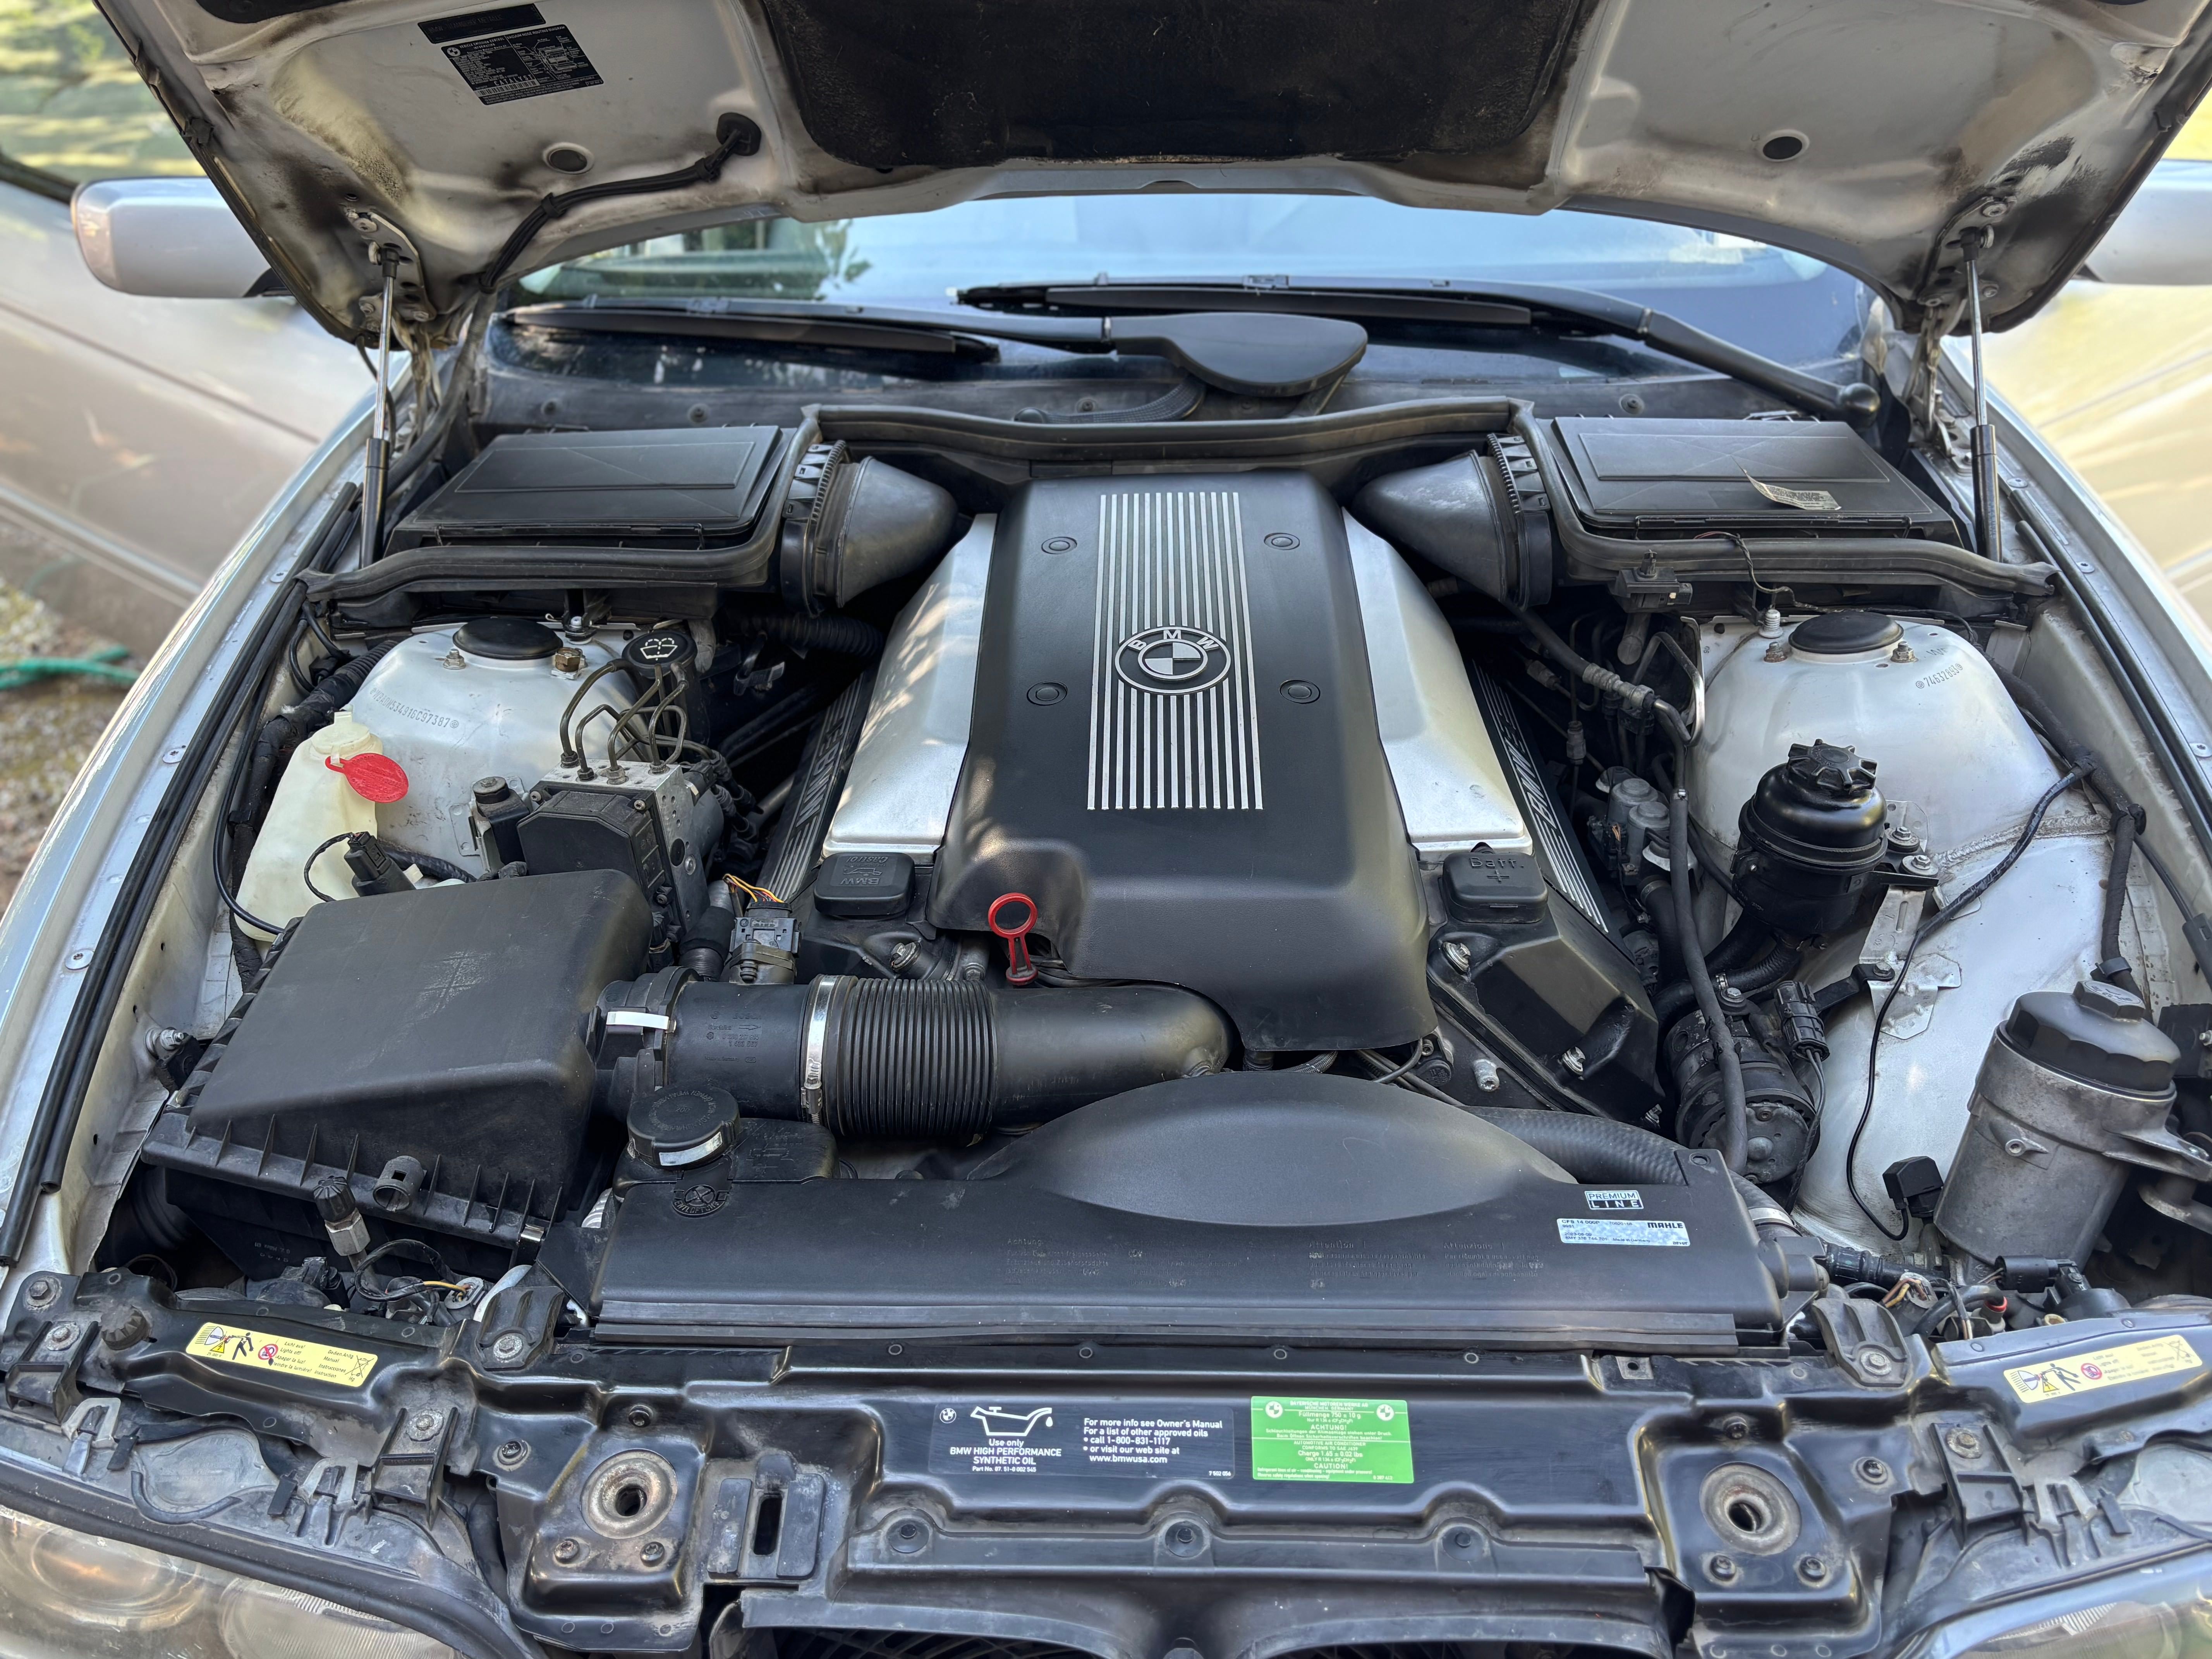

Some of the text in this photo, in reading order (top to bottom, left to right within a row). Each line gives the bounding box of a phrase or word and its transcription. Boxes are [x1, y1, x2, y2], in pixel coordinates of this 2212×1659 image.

[494, 74, 533, 86] CATALYST
[1128, 630, 1219, 651] BMW
[1469, 857, 1524, 869] Batt.
[840, 877, 880, 886] BMW
[318, 1364, 346, 1372] Instrucciones
[1084, 1418, 1098, 1426] For
[1124, 1419, 1139, 1427] info
[1157, 1419, 1190, 1428] Owner's
[1107, 1427, 1119, 1435] list
[1154, 1429, 1191, 1437] approved
[1007, 1439, 1024, 1448] only
[974, 1447, 994, 1455] HIGH
[997, 1448, 1061, 1456] PERFORMANCE
[1089, 1455, 1168, 1463] www.bmwusa.com
